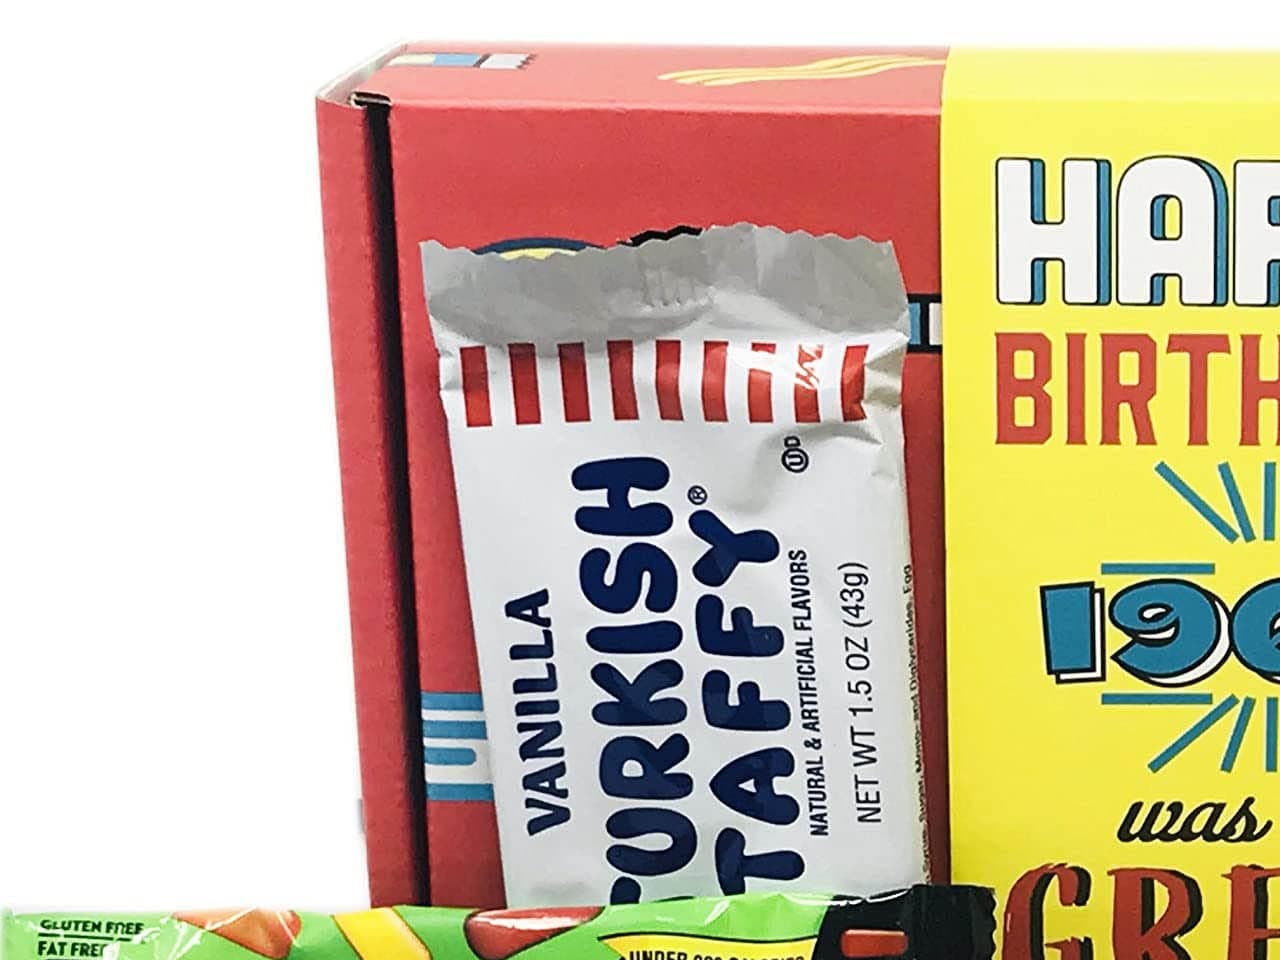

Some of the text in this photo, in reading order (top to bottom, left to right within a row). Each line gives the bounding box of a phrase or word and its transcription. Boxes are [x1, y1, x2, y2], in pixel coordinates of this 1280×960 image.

[505, 588, 572, 836] VANILLA
[688, 509, 806, 896] TAFFY
[788, 550, 829, 836] NATURAL & ARTIFICIAL FLAVORS
[837, 562, 882, 823] NET WT 1.5 OZ (43g)
[40, 919, 102, 932] GLUTEN
[1116, 798, 1273, 843] was
[38, 941, 68, 956] FAT
